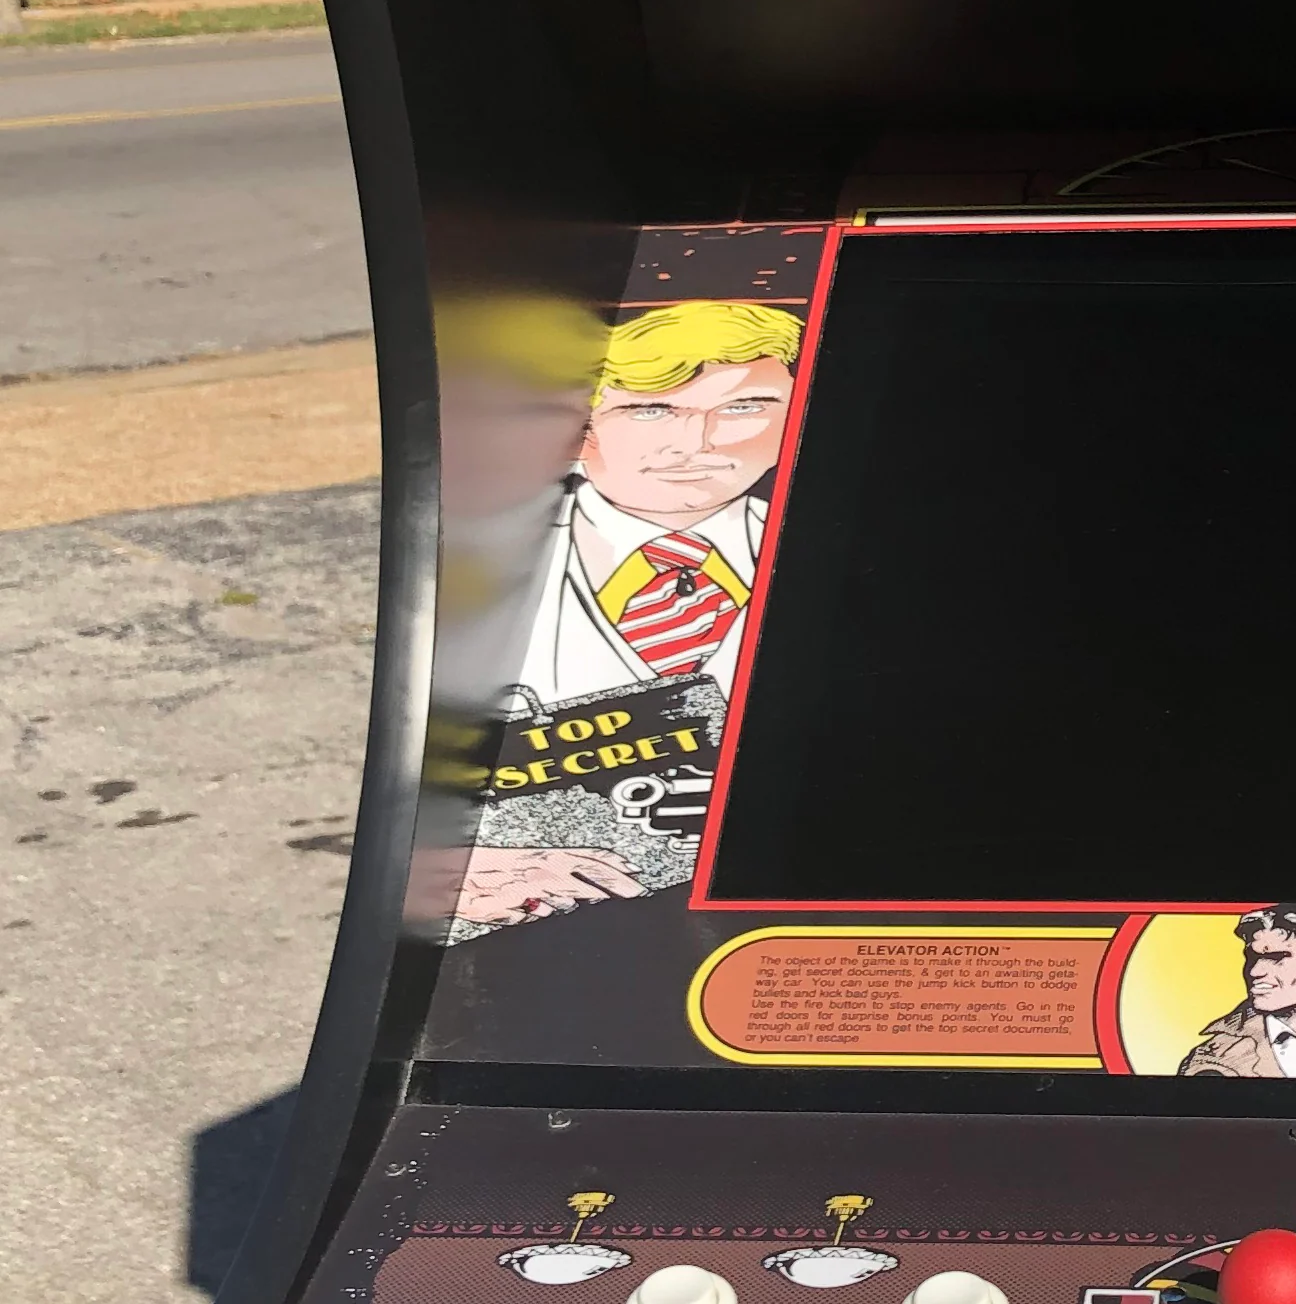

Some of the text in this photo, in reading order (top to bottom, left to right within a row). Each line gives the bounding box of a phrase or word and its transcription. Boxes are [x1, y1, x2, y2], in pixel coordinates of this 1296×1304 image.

[520, 710, 632, 751] TOP
[494, 727, 699, 790] SECRET
[857, 945, 937, 956] ELEVATOR
[760, 956, 1080, 969] The object of the game is to make it through the build-
[782, 968, 801, 978] get
[806, 968, 843, 976] secret
[920, 968, 929, 977] &
[934, 968, 954, 979] get
[959, 968, 970, 977] to
[995, 969, 1044, 980] awaiting
[1048, 969, 1079, 980] geta-
[755, 979, 779, 988] way
[812, 978, 835, 988] You
[868, 980, 889, 988] use
[894, 979, 913, 988] the
[917, 979, 948, 990] jump
[953, 979, 976, 988] kick
[981, 979, 1019, 989] button
[1024, 980, 1035, 989] to
[1041, 980, 1078, 991] dodge
[753, 989, 869, 998] bullets and bad
[751, 999, 1075, 1012] Use the fire button to stop enemy Go in the
[749, 1011, 1074, 1025] red doors for surprise bonus You must go
[747, 1022, 999, 1034] through all red doors to get the top secret
[745, 1033, 813, 1043] or you can't
